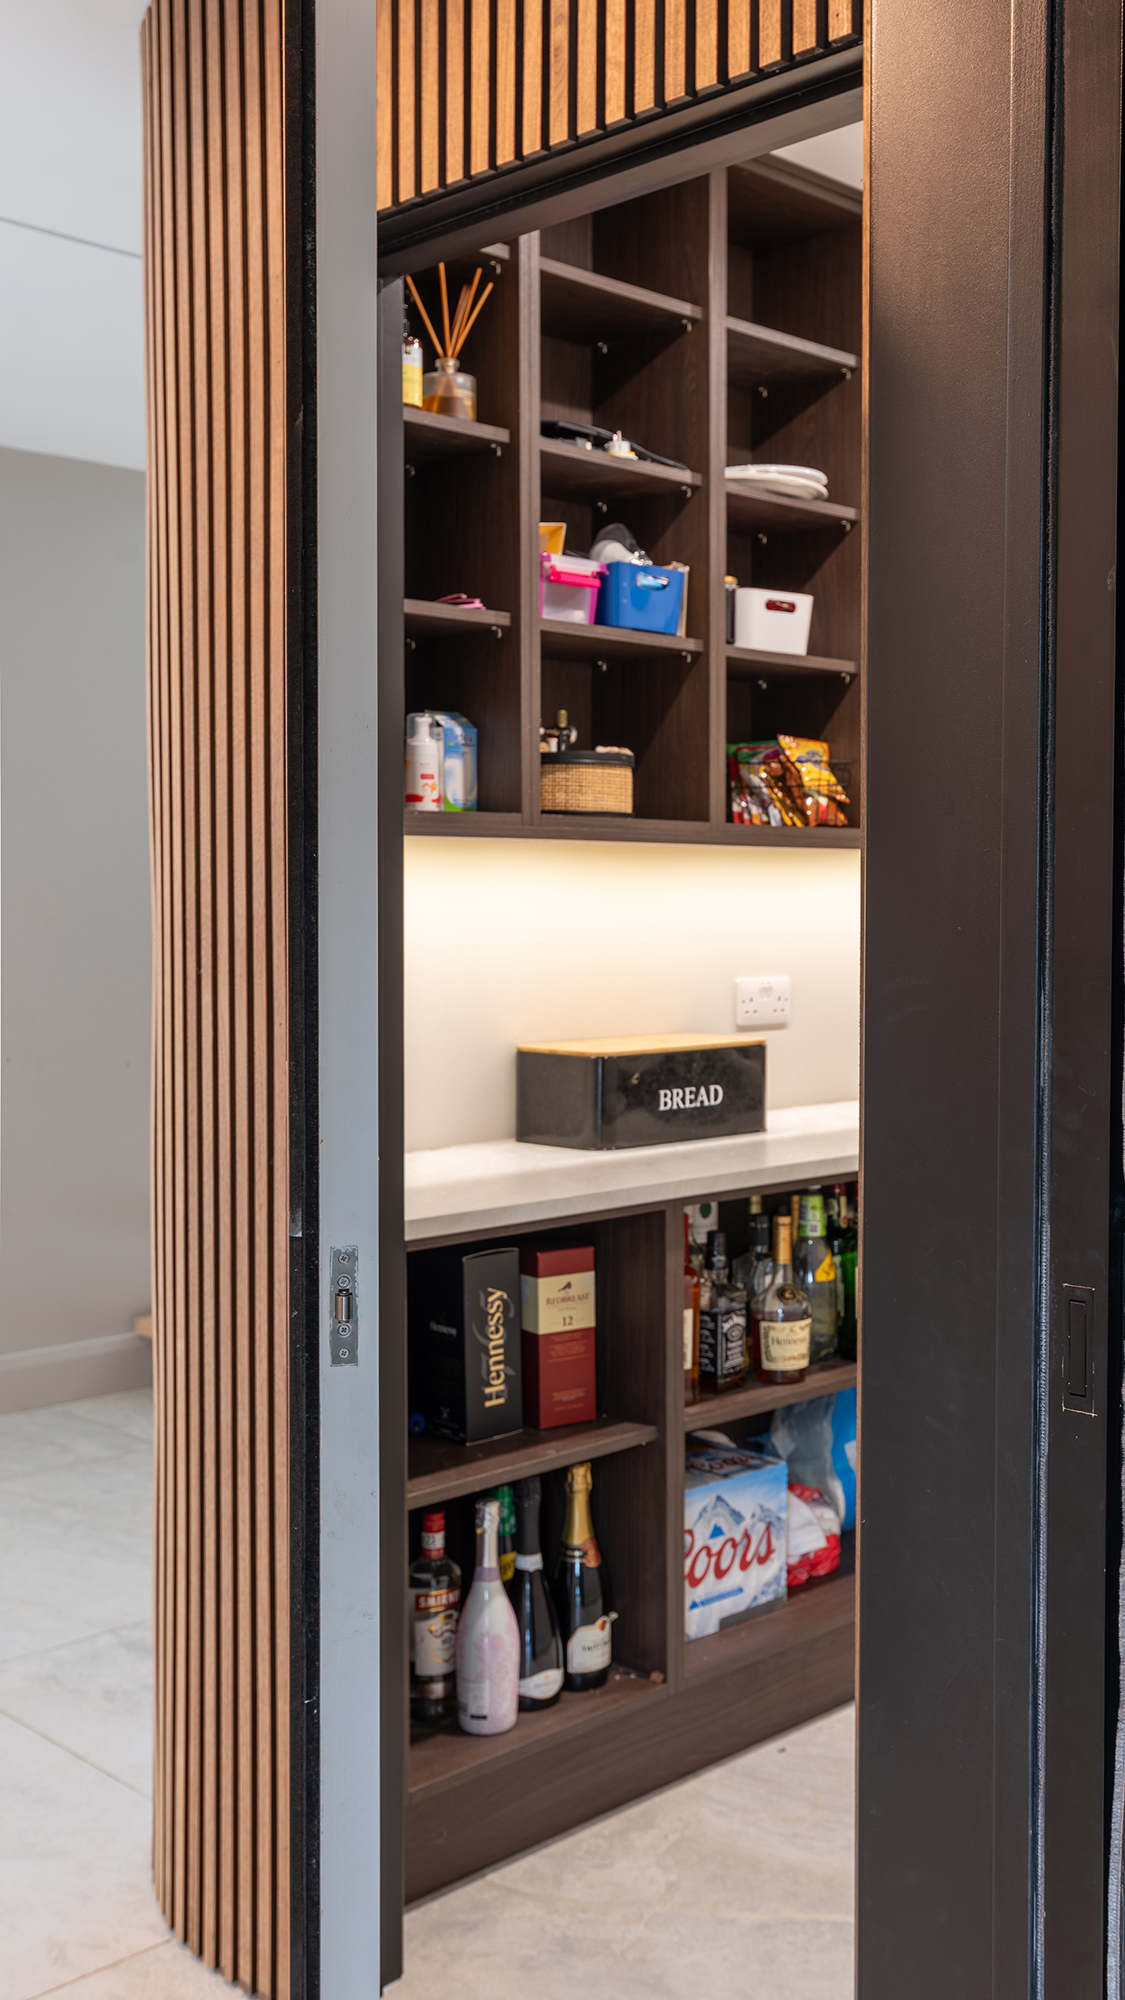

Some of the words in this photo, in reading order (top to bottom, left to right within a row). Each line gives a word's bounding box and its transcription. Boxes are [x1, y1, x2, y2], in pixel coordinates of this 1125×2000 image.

[658, 1084, 724, 1112] BREAD
[562, 1314, 574, 1327] 12
[484, 1287, 508, 1408] Hennessy
